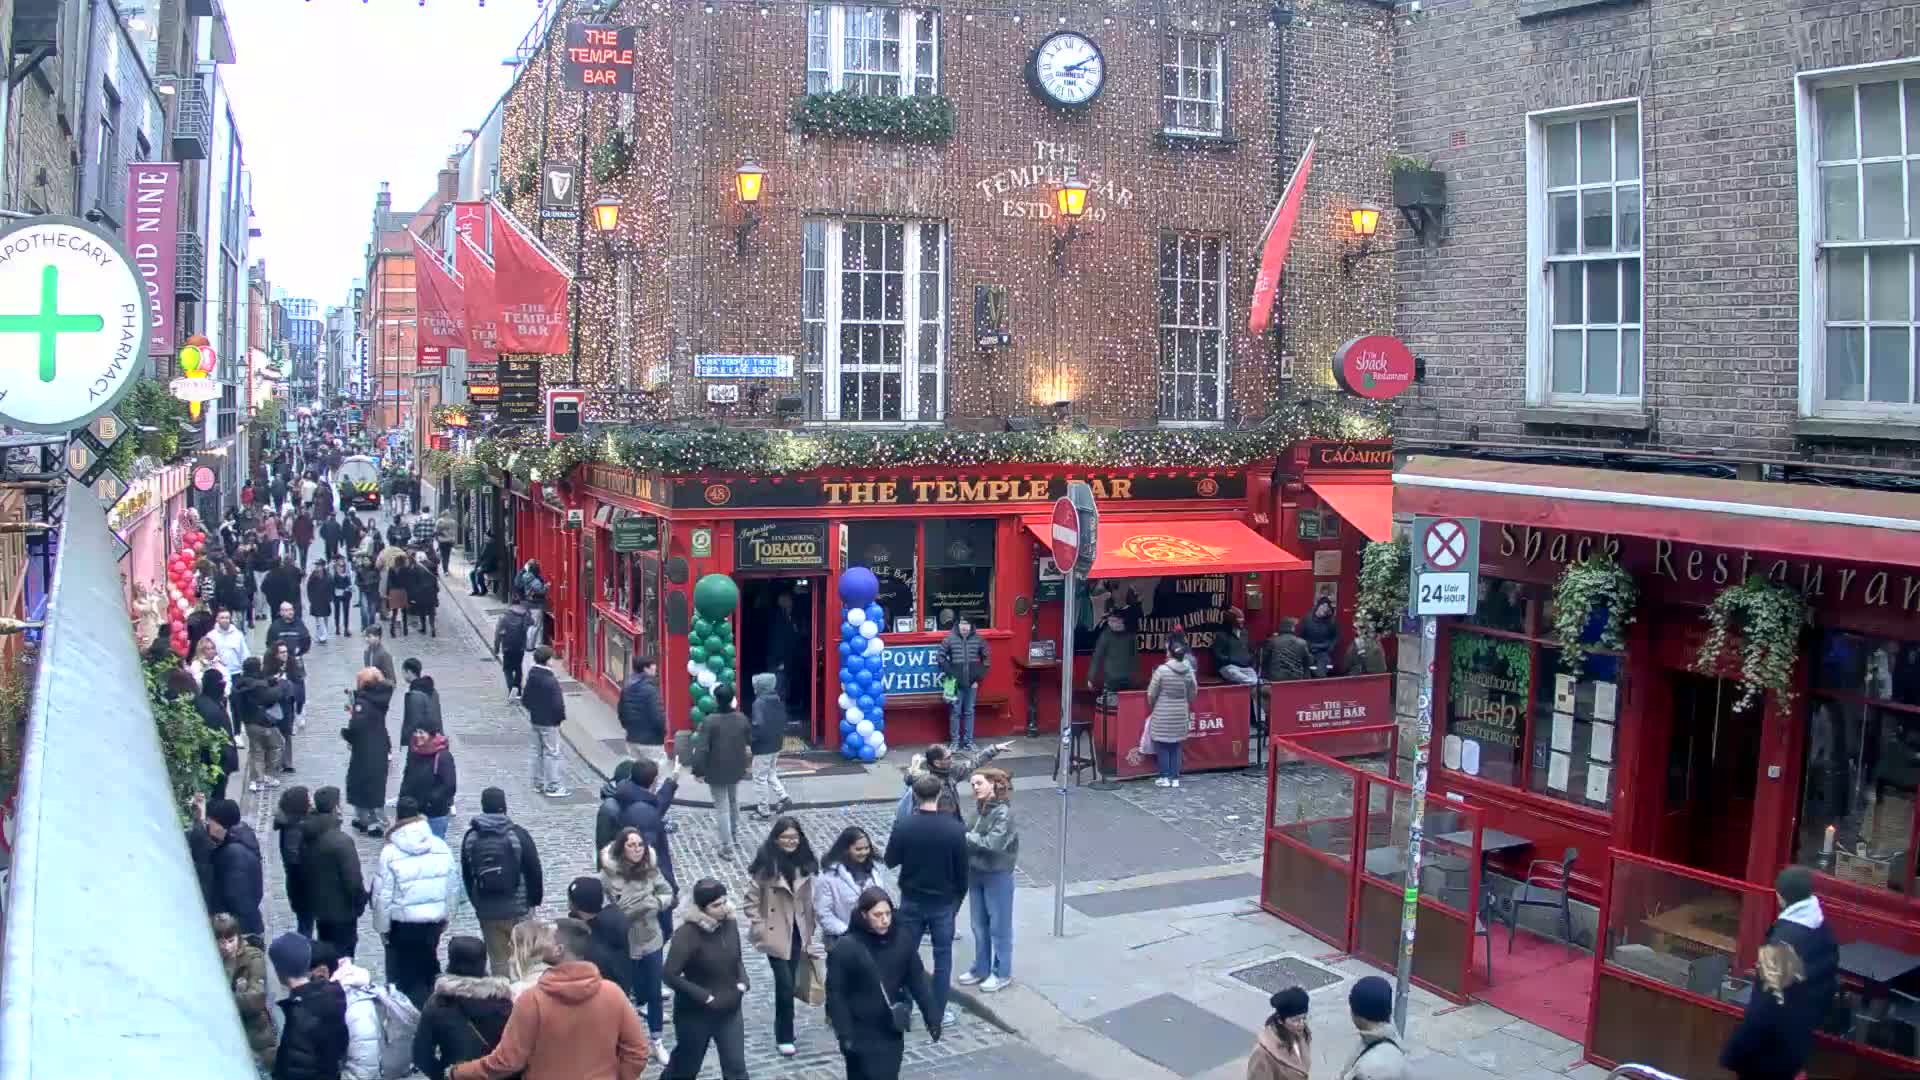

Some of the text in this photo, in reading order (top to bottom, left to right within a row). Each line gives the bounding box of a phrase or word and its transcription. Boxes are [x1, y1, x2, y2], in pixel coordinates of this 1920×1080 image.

[585, 29, 617, 45] THE
[568, 48, 633, 65] TEMPLE
[583, 69, 617, 85] BAR
[1055, 71, 1085, 79] GUINNESS
[1033, 140, 1080, 163] THE
[975, 162, 1078, 201] TEMPLE
[1088, 175, 1134, 209] BAR
[137, 171, 169, 233] NINE
[541, 210, 576, 218] GUINNESS
[520, 304, 545, 314] THE
[503, 312, 562, 326] TEMPLE
[432, 327, 456, 336] BAR
[517, 324, 550, 337] BAR
[88, 303, 136, 404] PHARMACY
[509, 362, 529, 371] BAR
[752, 366, 777, 374] SOUTH
[635, 477, 652, 500] BAR
[823, 479, 1133, 504] THE TEMPLE AR
[750, 539, 816, 561] TOBACCO
[1500, 524, 1920, 612] Shack Restauran
[1176, 578, 1225, 593] EMPEROR
[1211, 593, 1225, 608] OF
[1421, 584, 1443, 603] 24
[1443, 595, 1466, 603] HOUR
[1323, 701, 1342, 710] THE
[1296, 706, 1367, 721] TEMPLE BAR
[1199, 717, 1225, 730] BAR
